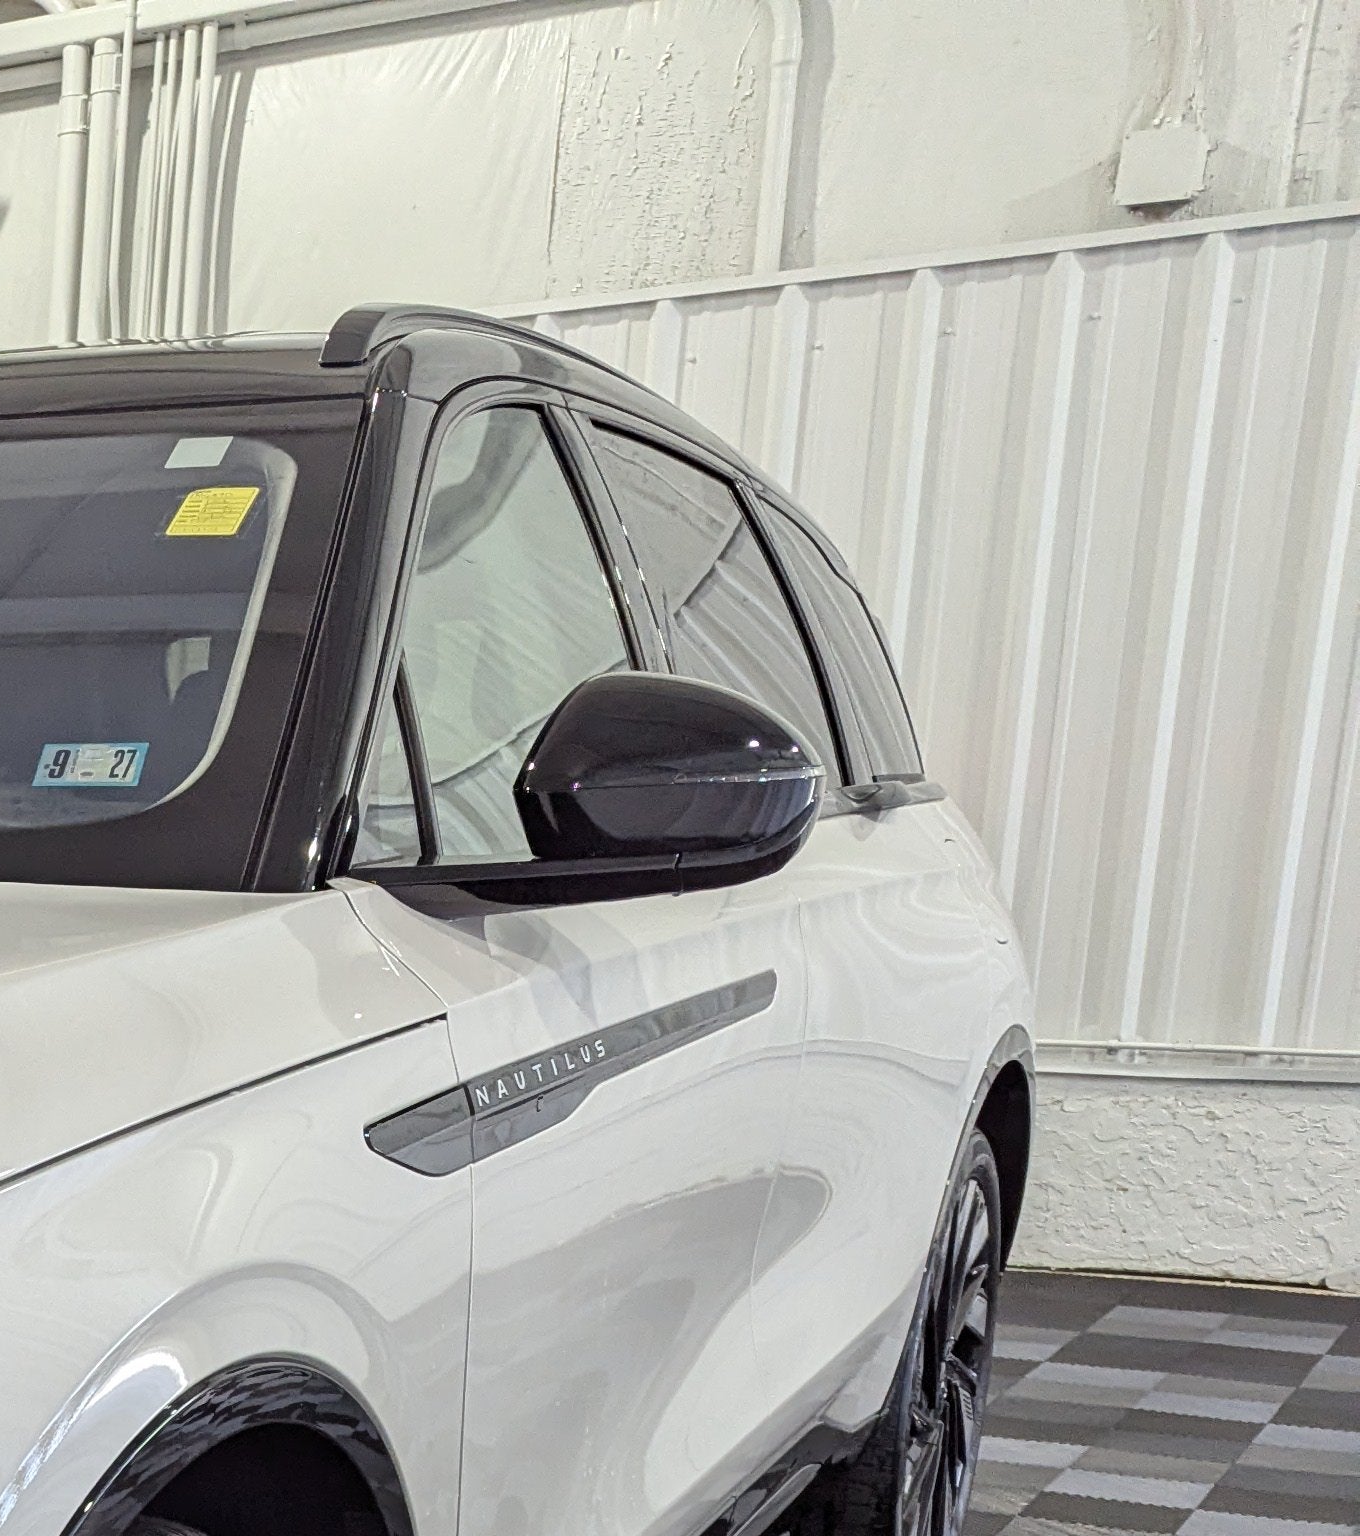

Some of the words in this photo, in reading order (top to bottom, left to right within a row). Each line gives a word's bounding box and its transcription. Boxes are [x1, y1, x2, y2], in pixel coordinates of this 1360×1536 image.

[48, 749, 71, 779] 9
[108, 749, 138, 779] 27
[475, 1038, 607, 1108] NAUTILUS
